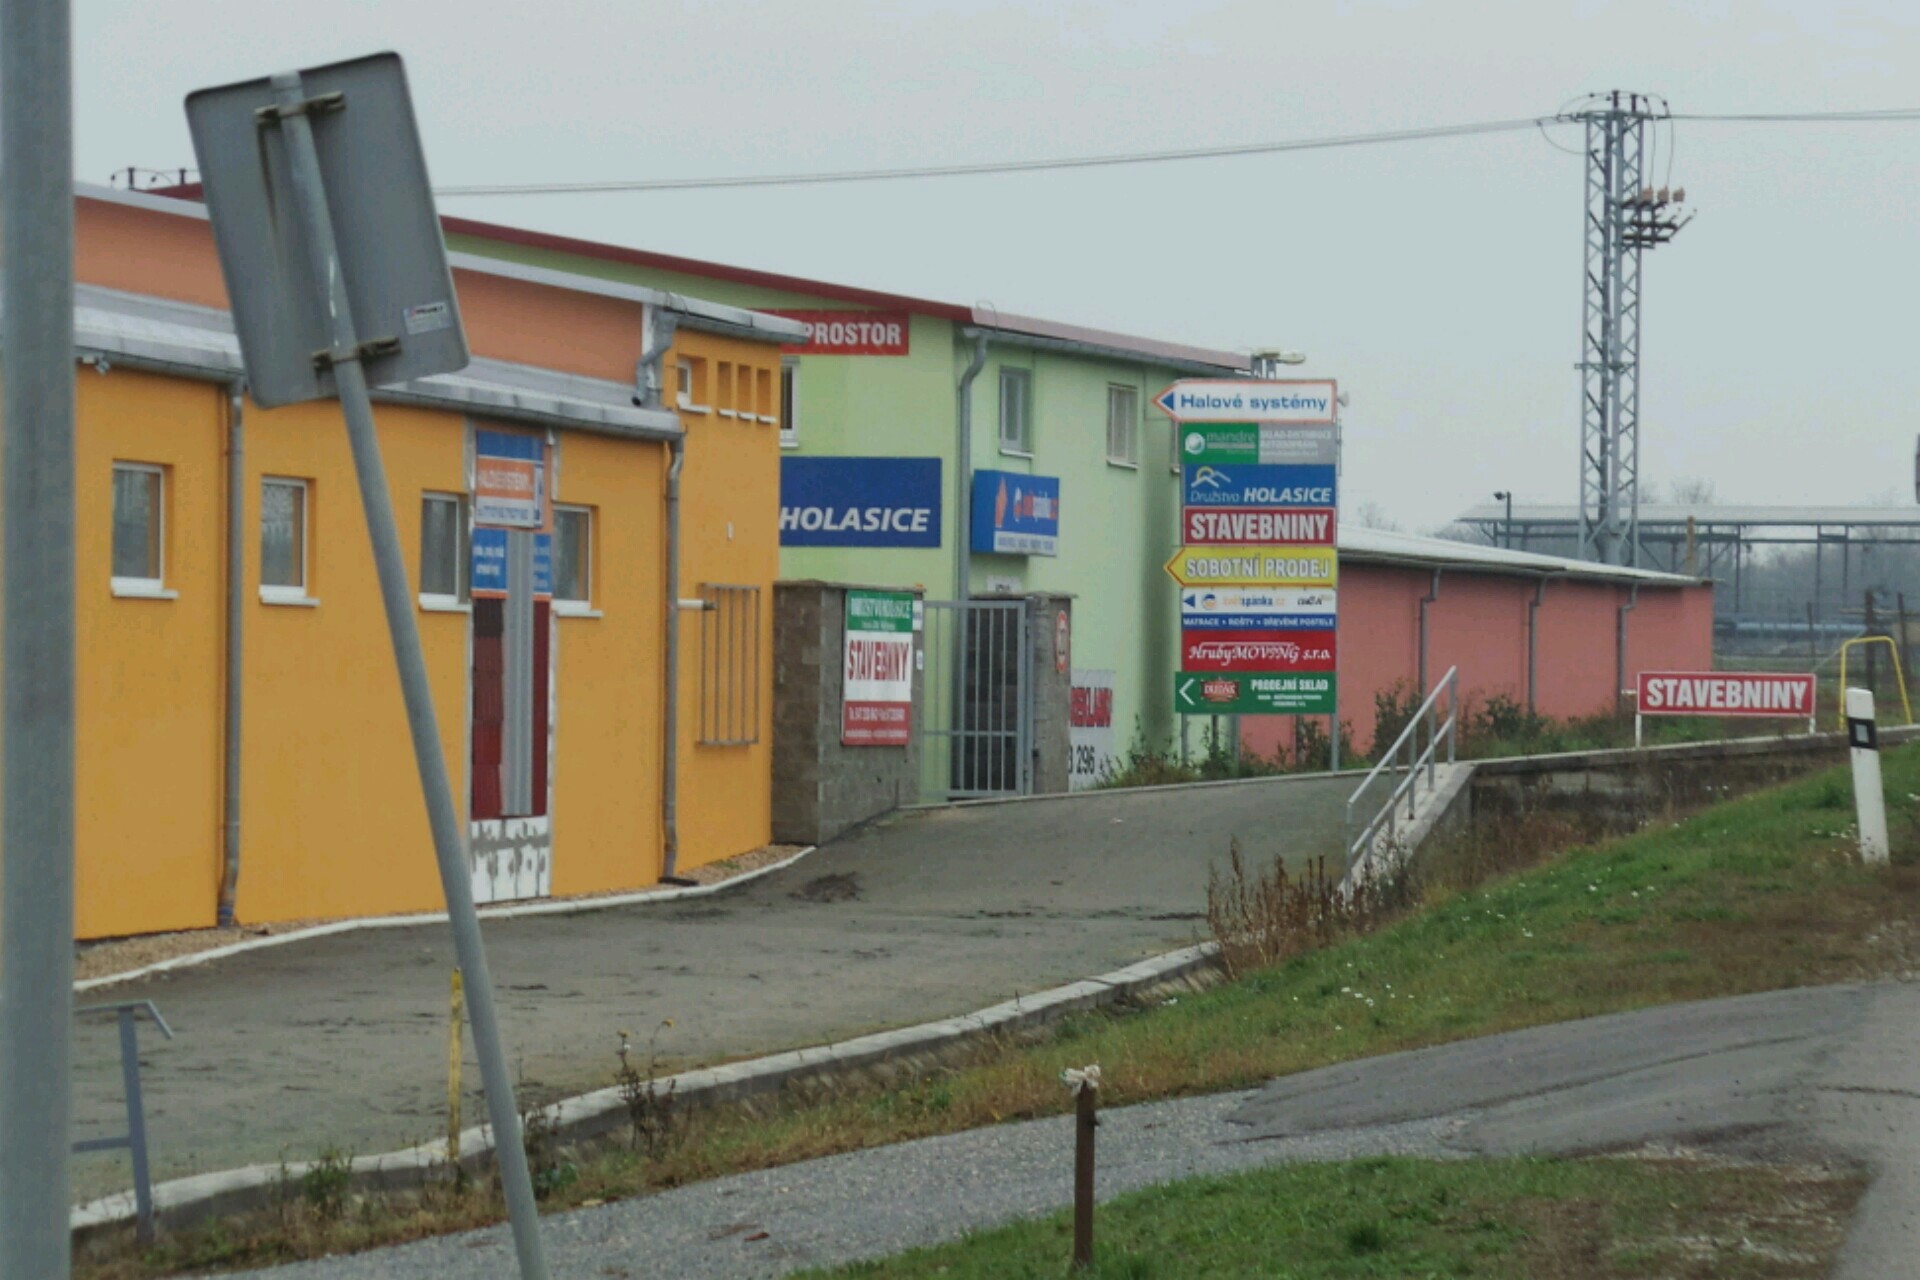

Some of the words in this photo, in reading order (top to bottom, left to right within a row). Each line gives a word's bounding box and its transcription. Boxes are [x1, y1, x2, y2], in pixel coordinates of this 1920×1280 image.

[802, 322, 902, 346] PROSTOR
[1180, 393, 1243, 409] Halové
[1250, 393, 1327, 412] systémy
[1243, 487, 1332, 503] HOLASICE
[778, 506, 931, 533] HOLASICE
[1190, 512, 1329, 540] STAVEBNINY
[1186, 553, 1261, 578] SOBOTNÍ
[1265, 558, 1330, 578] PRODEJ
[1183, 617, 1220, 627] MATRACE
[1251, 677, 1297, 692] PRODEJNÍ
[1299, 678, 1329, 692] SKLAD
[1647, 678, 1808, 709] STAVEBNINY
